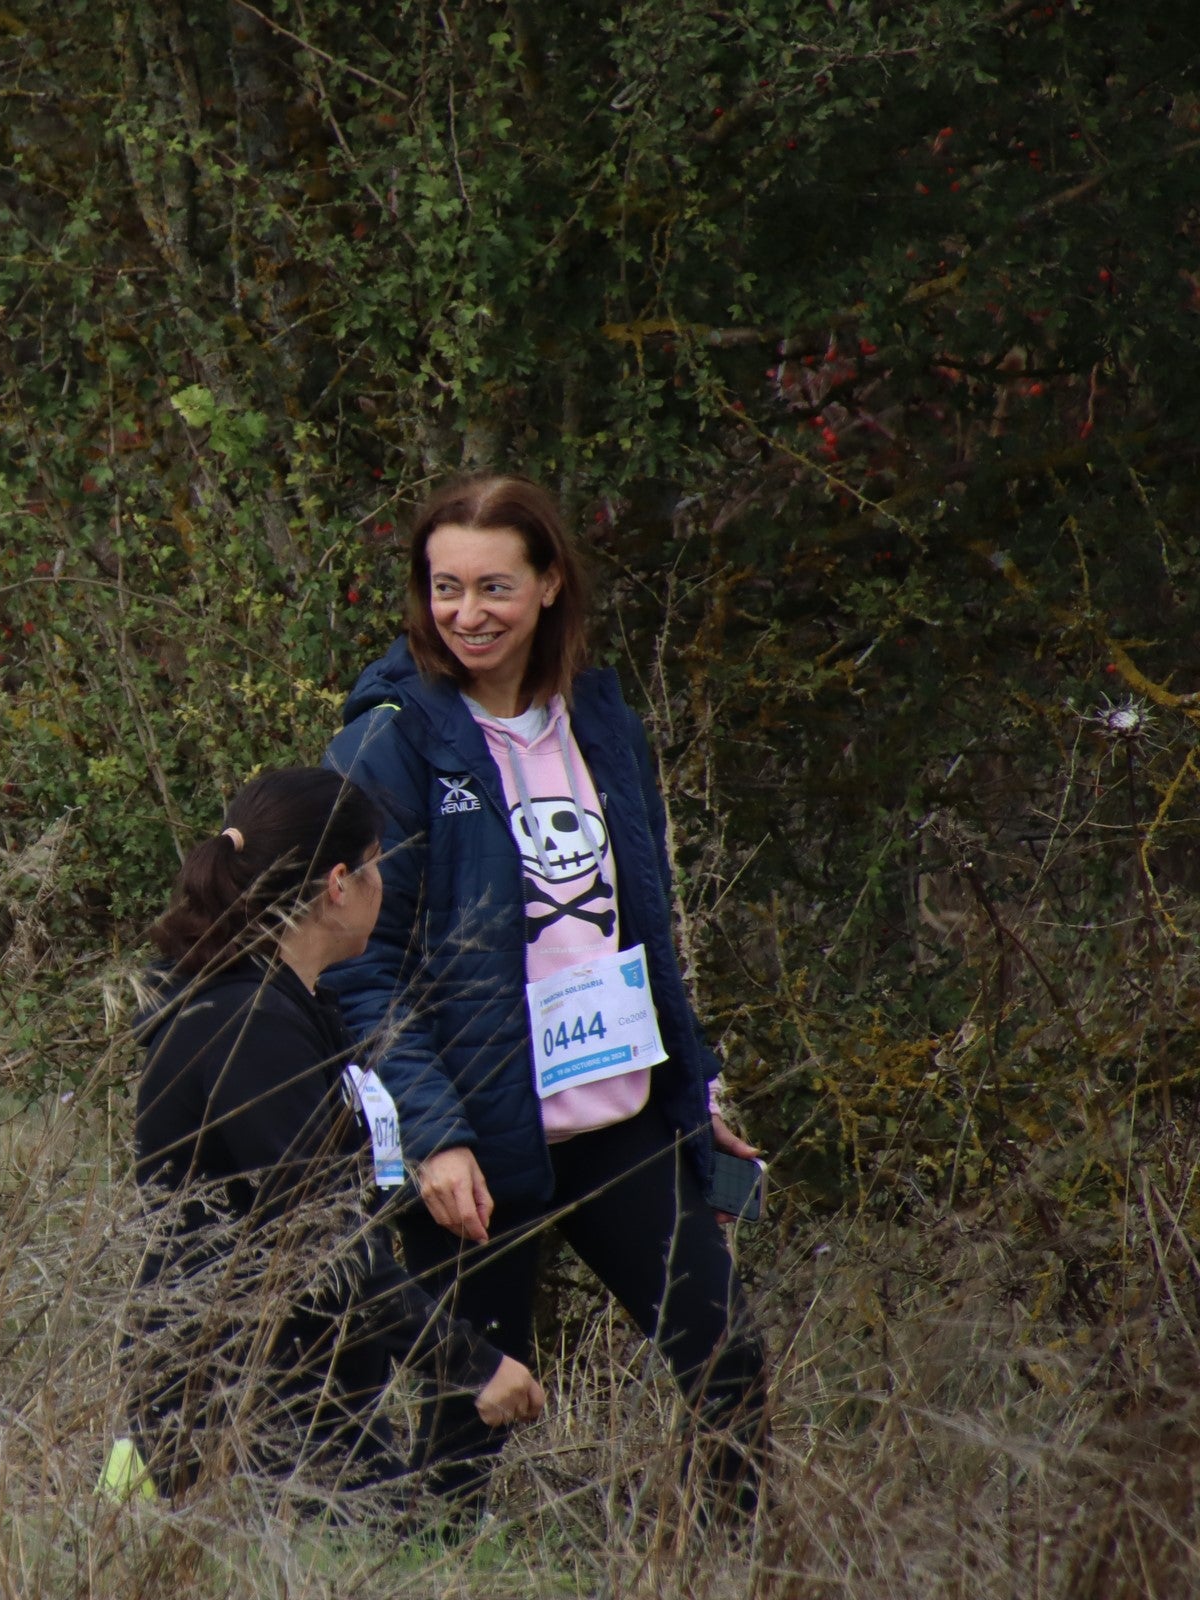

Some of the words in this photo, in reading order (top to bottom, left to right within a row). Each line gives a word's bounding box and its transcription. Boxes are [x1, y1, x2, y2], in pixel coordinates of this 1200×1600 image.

[564, 978, 604, 996] SOLIDARIA
[543, 1010, 607, 1057] 0444
[571, 1057, 602, 1073] OCTUBRE
[602, 1053, 611, 1064] de
